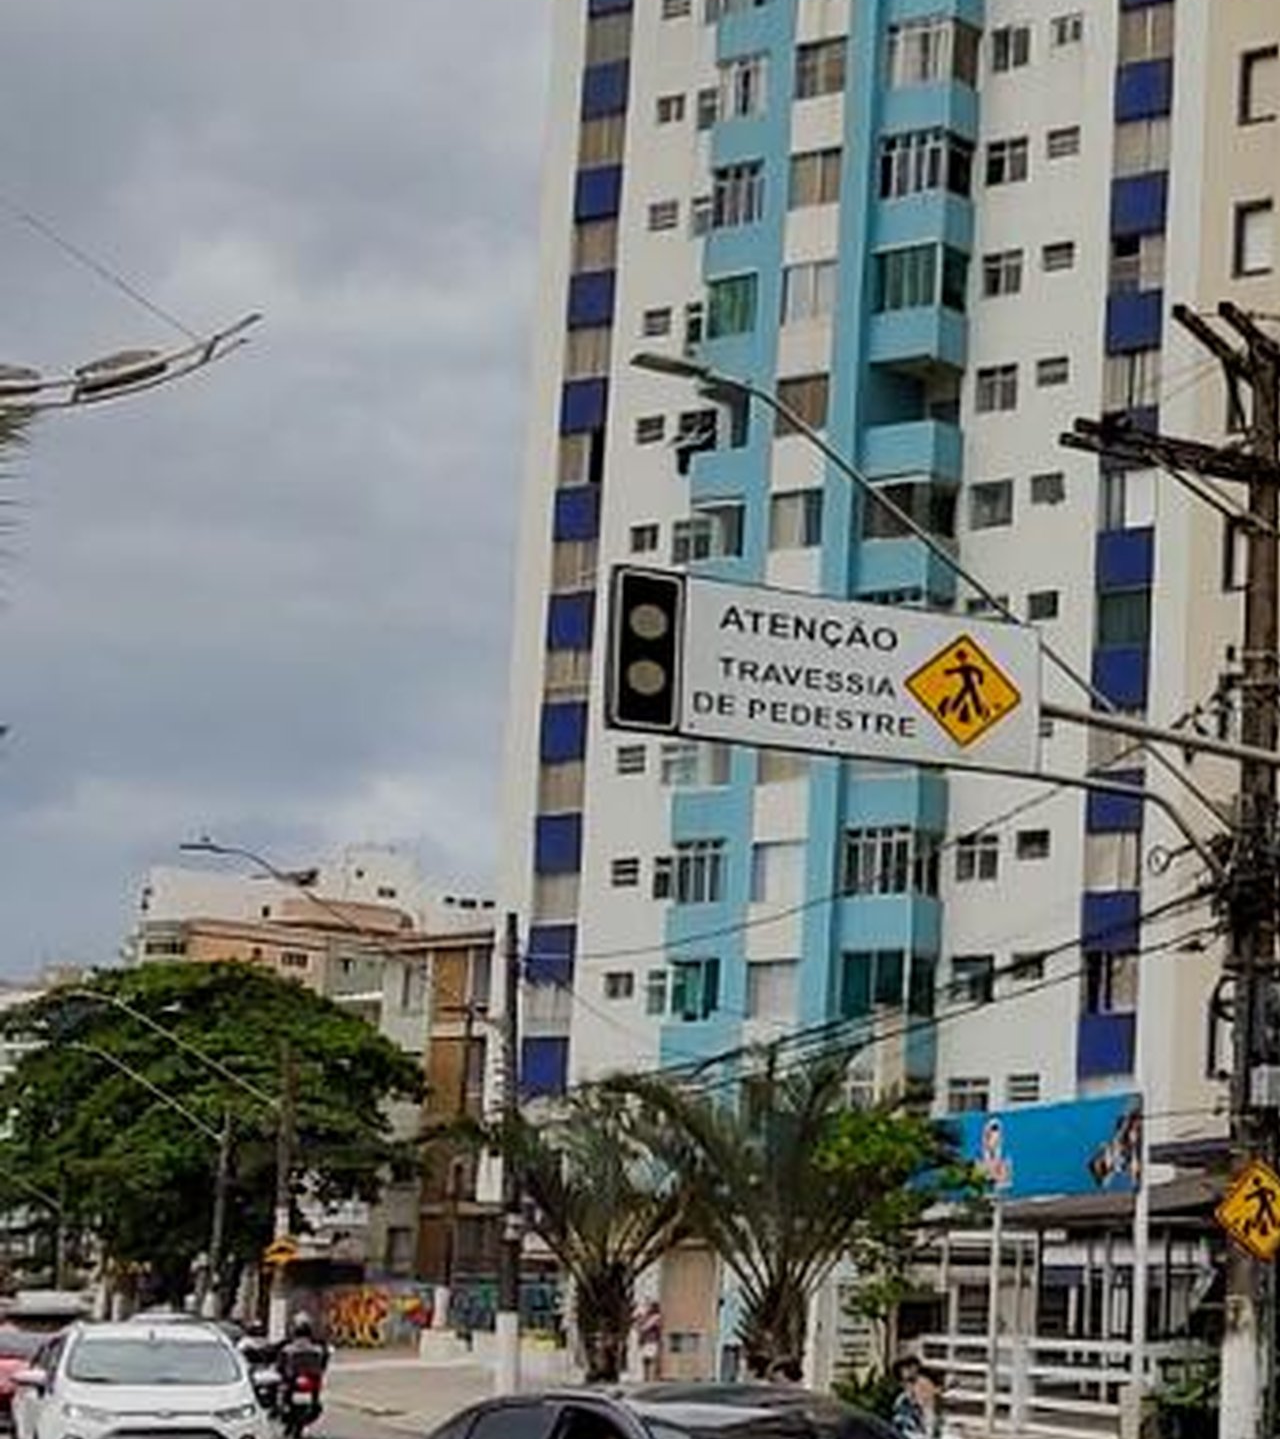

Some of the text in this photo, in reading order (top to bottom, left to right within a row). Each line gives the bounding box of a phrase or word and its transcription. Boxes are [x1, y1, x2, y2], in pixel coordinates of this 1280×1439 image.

[719, 605, 899, 652] ATENÇÃO
[719, 656, 897, 699] TRAVESSIA
[692, 690, 918, 739] DE PEDESTRE
